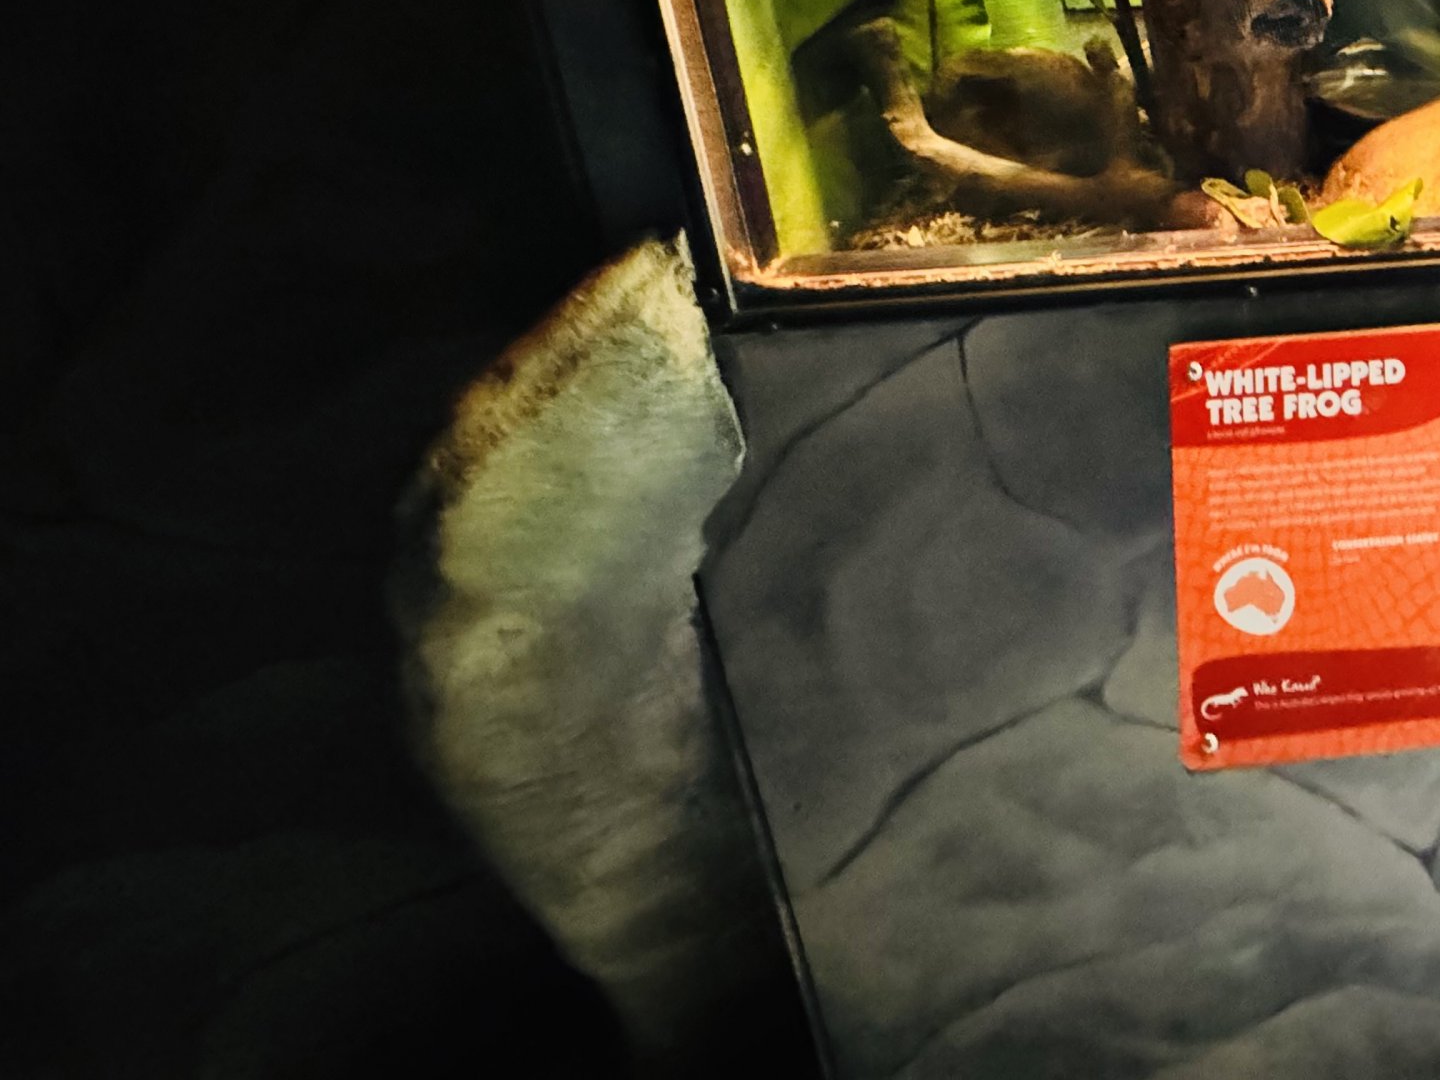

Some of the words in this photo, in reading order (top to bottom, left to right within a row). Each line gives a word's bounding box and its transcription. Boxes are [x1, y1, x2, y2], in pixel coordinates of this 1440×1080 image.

[1205, 358, 1406, 397] WHITE-LIPPED
[1205, 395, 1275, 425] TREE
[1283, 389, 1362, 420] FROG
